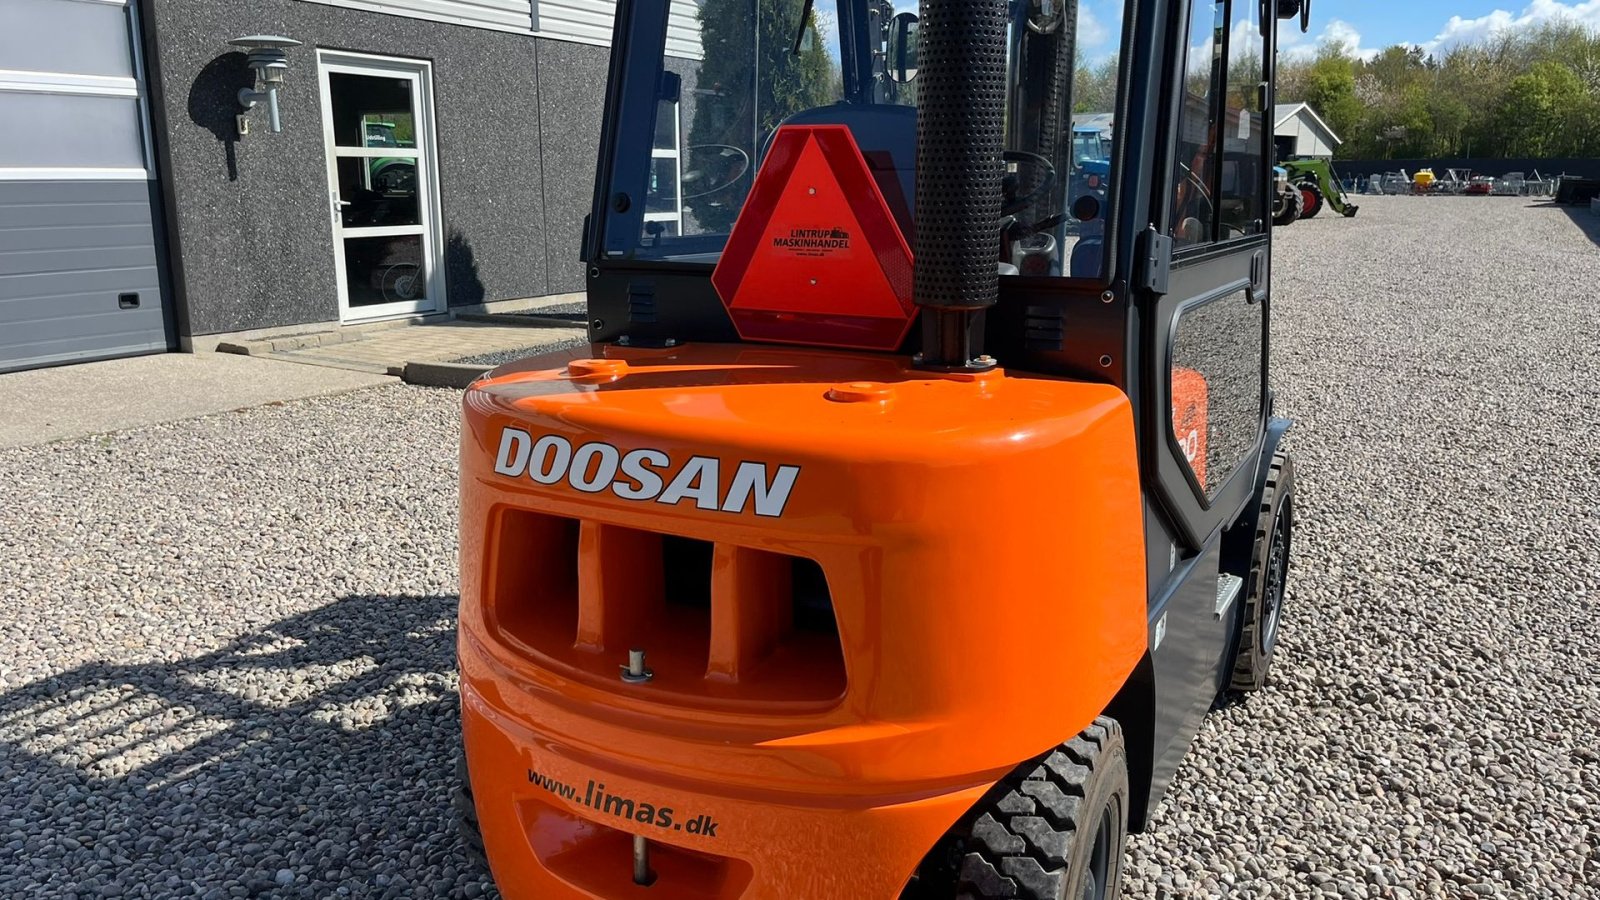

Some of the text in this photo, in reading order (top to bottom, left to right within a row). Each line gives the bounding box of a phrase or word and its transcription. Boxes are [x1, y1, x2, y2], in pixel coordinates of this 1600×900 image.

[773, 238, 850, 249] MASKINHANDEL
[790, 229, 831, 239] LINTRUP
[494, 426, 801, 518] DOOSAN
[527, 768, 719, 838] www.limas.dk
